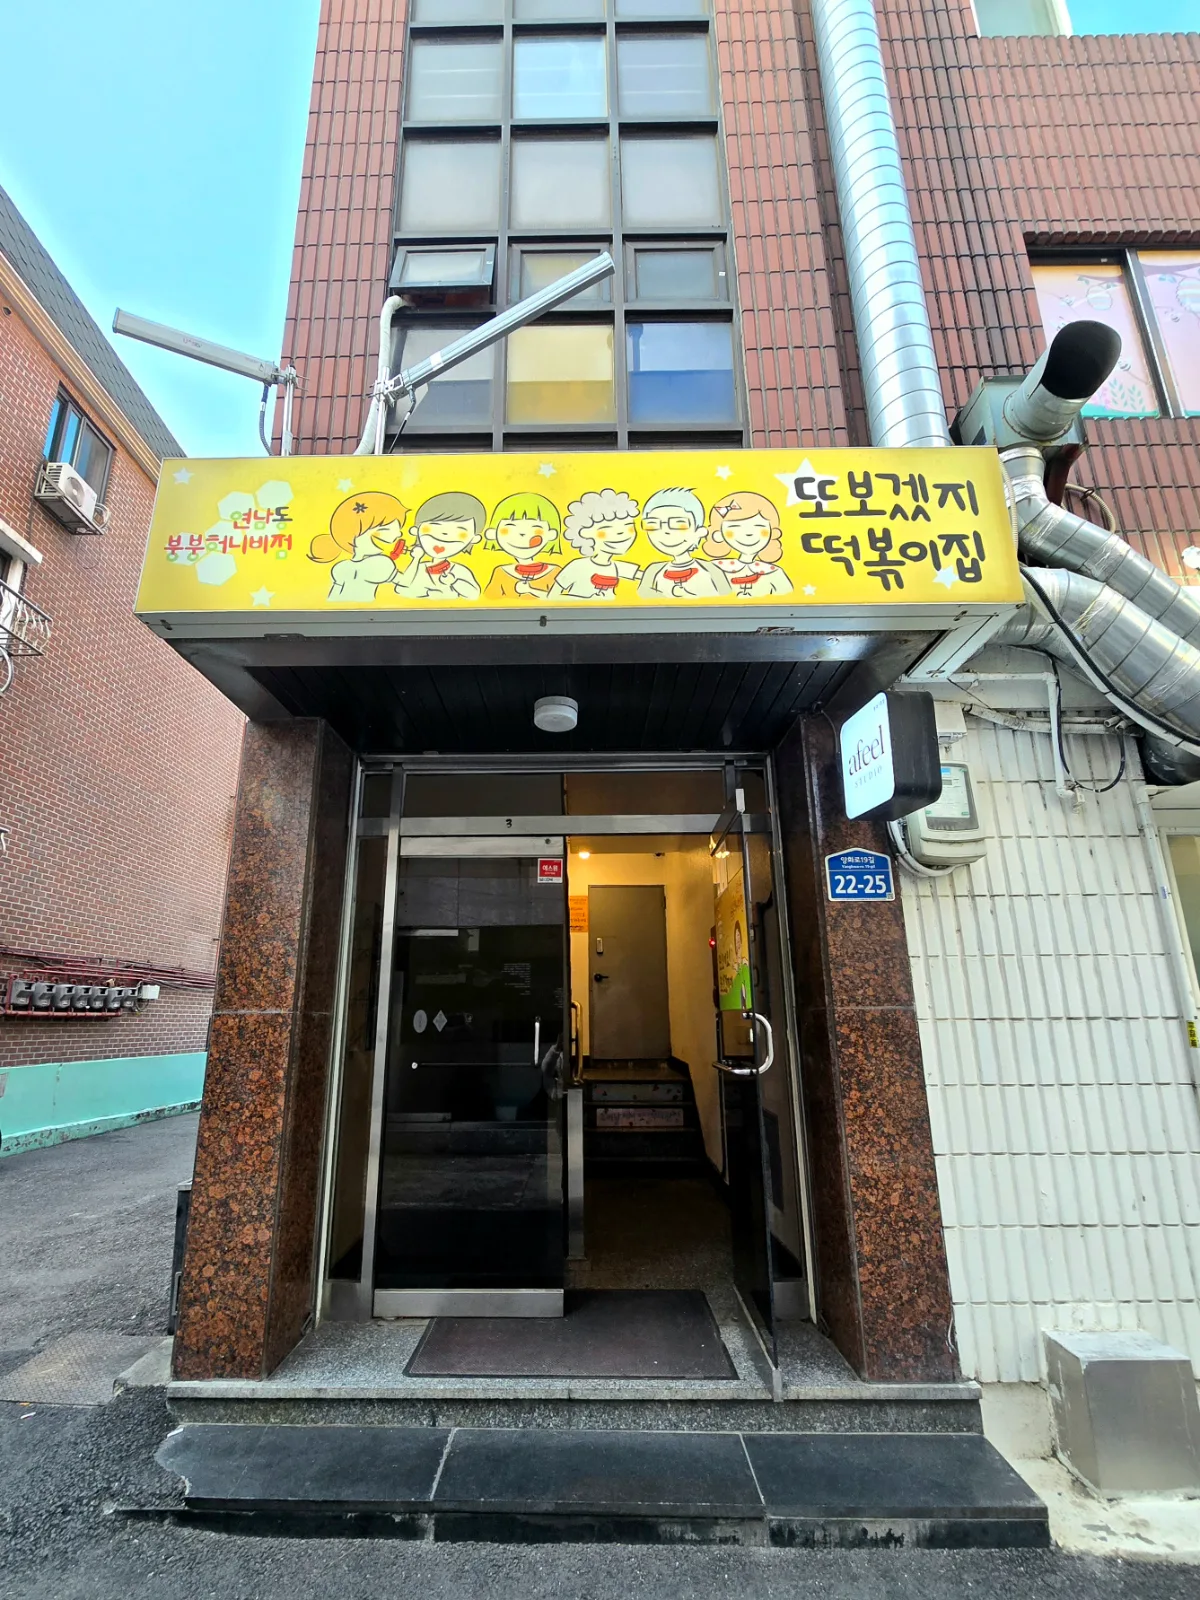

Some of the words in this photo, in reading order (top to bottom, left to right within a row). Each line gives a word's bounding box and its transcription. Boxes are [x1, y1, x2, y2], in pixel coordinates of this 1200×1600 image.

[794, 471, 979, 522] 또보겠지
[230, 506, 293, 530] 연남동
[164, 534, 292, 562] 붕붕허니비쩜
[801, 527, 985, 591] 떡볶이집
[848, 724, 885, 776] afeel
[854, 765, 883, 788] STUDIO
[834, 875, 887, 894] 22-25
